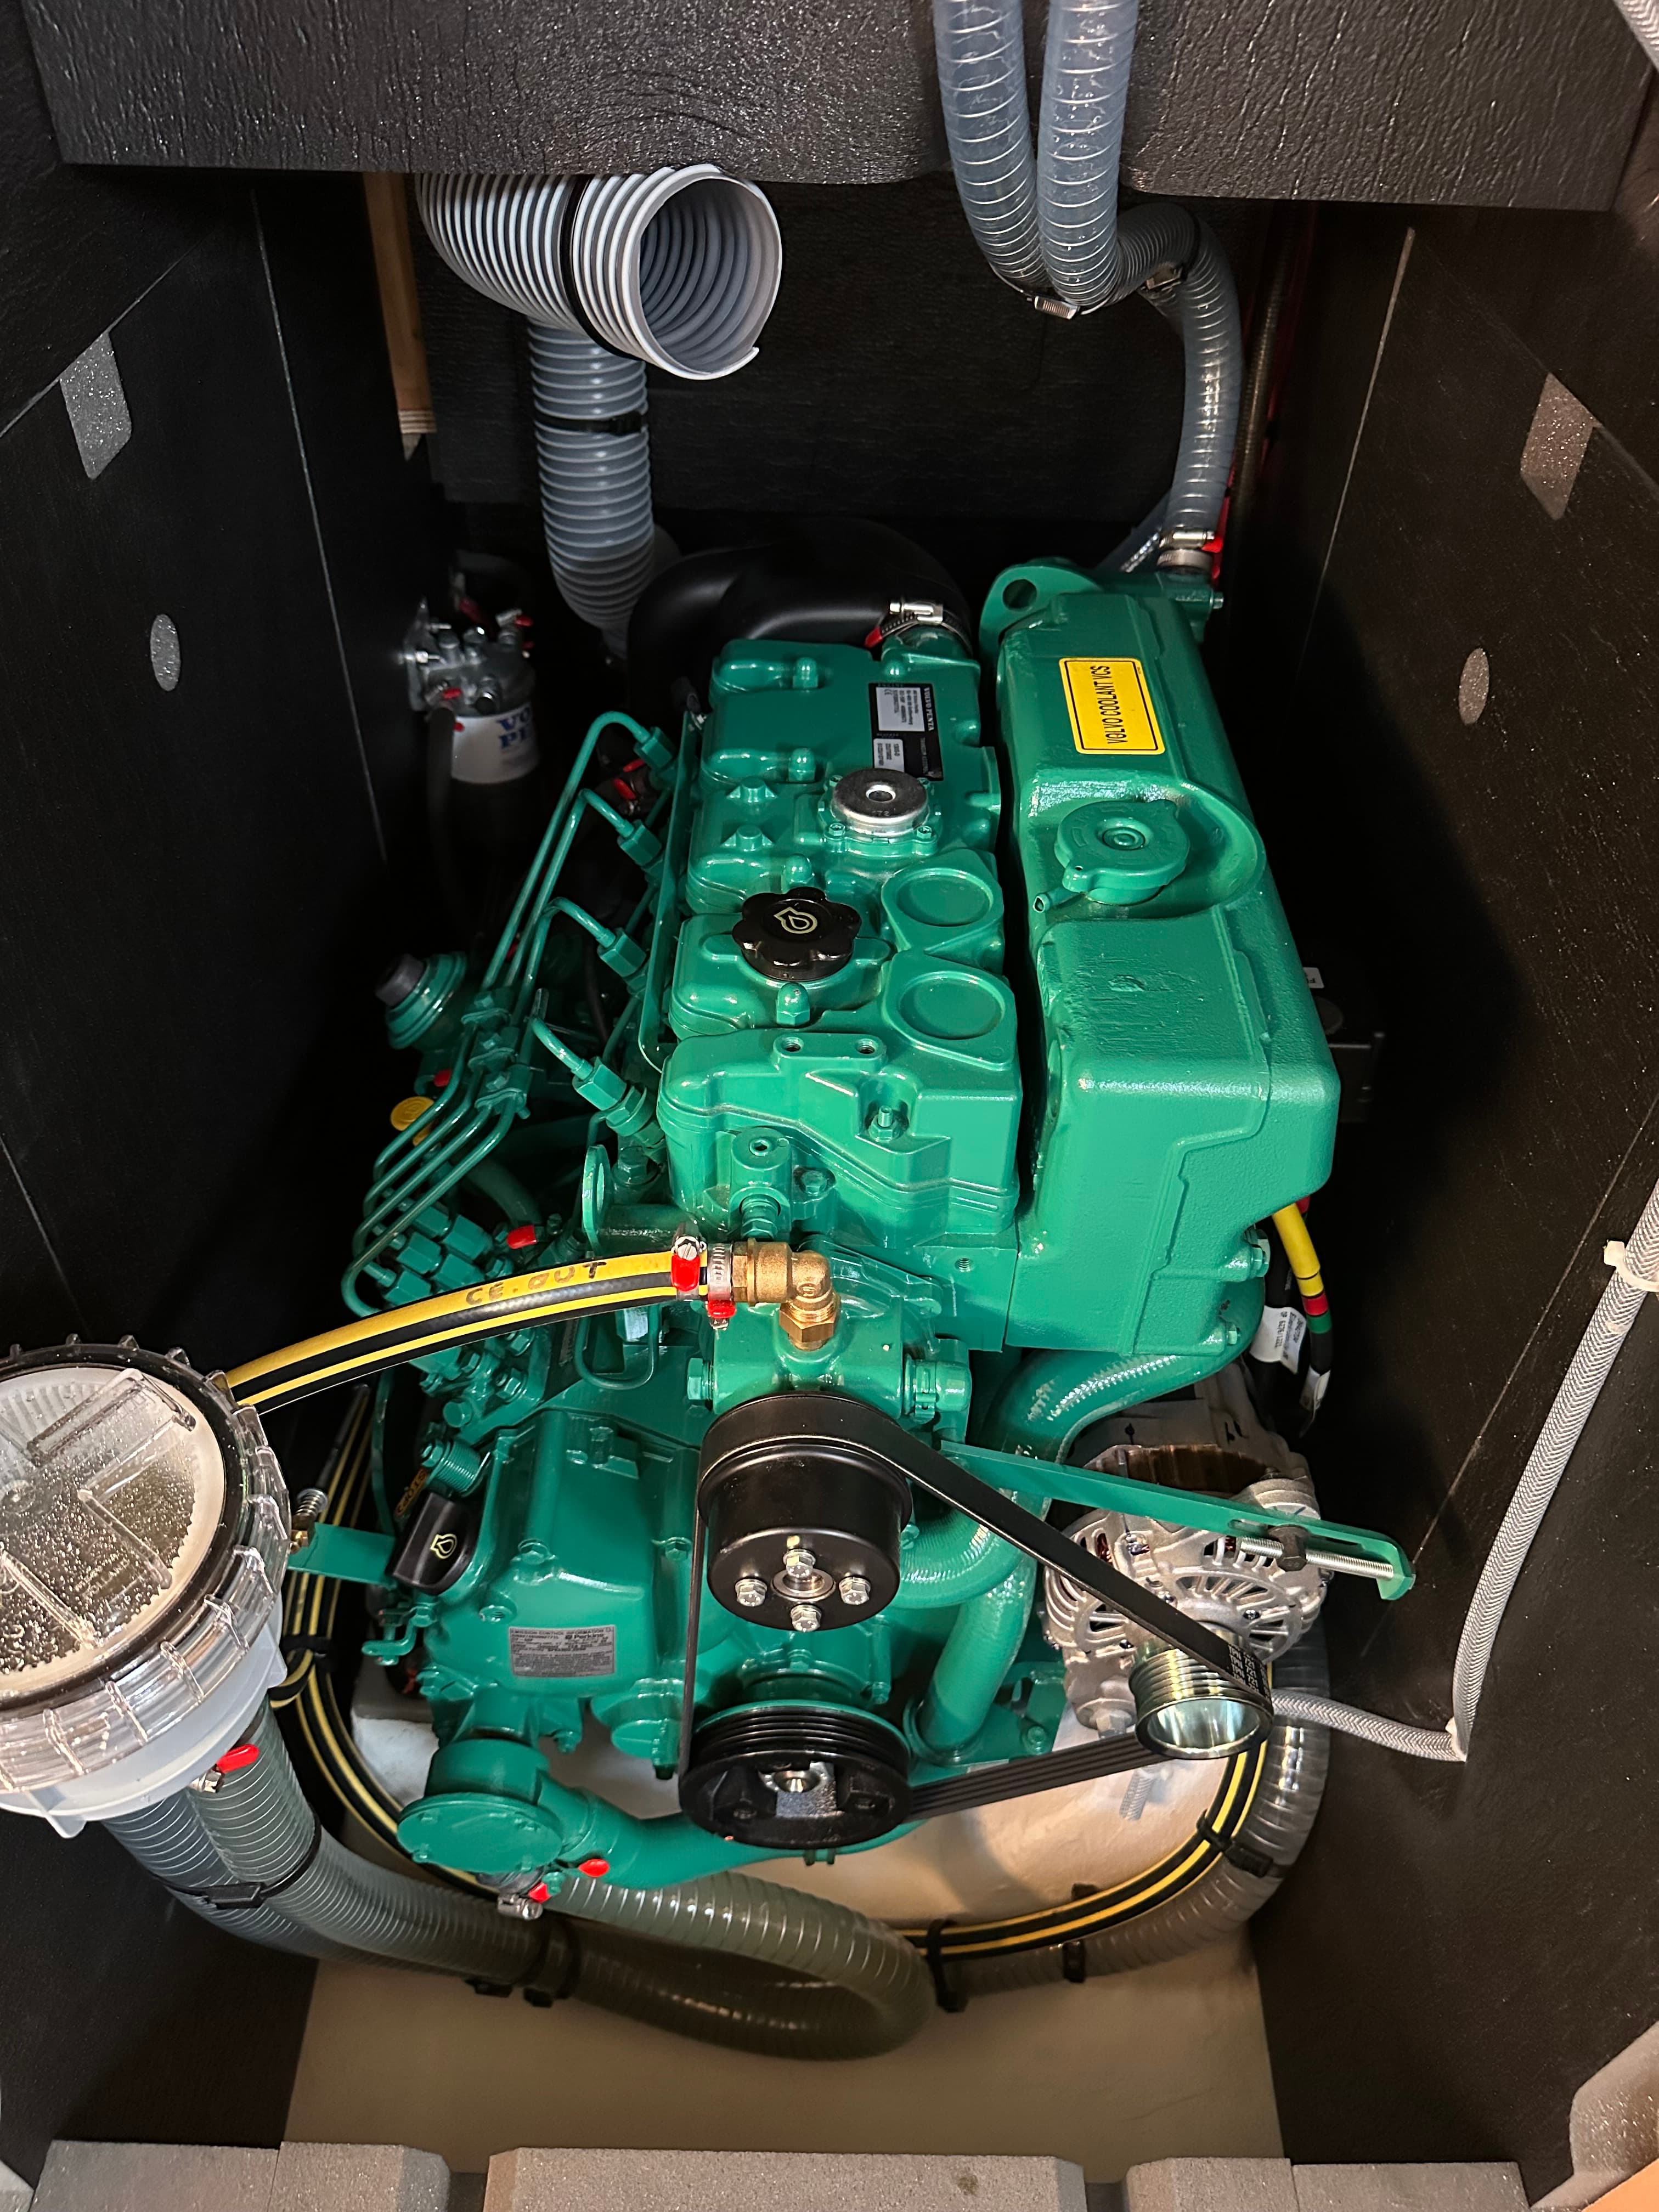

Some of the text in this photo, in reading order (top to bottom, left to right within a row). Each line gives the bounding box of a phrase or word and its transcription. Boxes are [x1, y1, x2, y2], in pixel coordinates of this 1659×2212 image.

[923, 687, 935, 732] VOLVO PENTA
[1090, 665, 1128, 744] VOLVO COOLANT VCS
[1244, 1664, 1257, 1679] 721
[1246, 1673, 1259, 1688] 721
